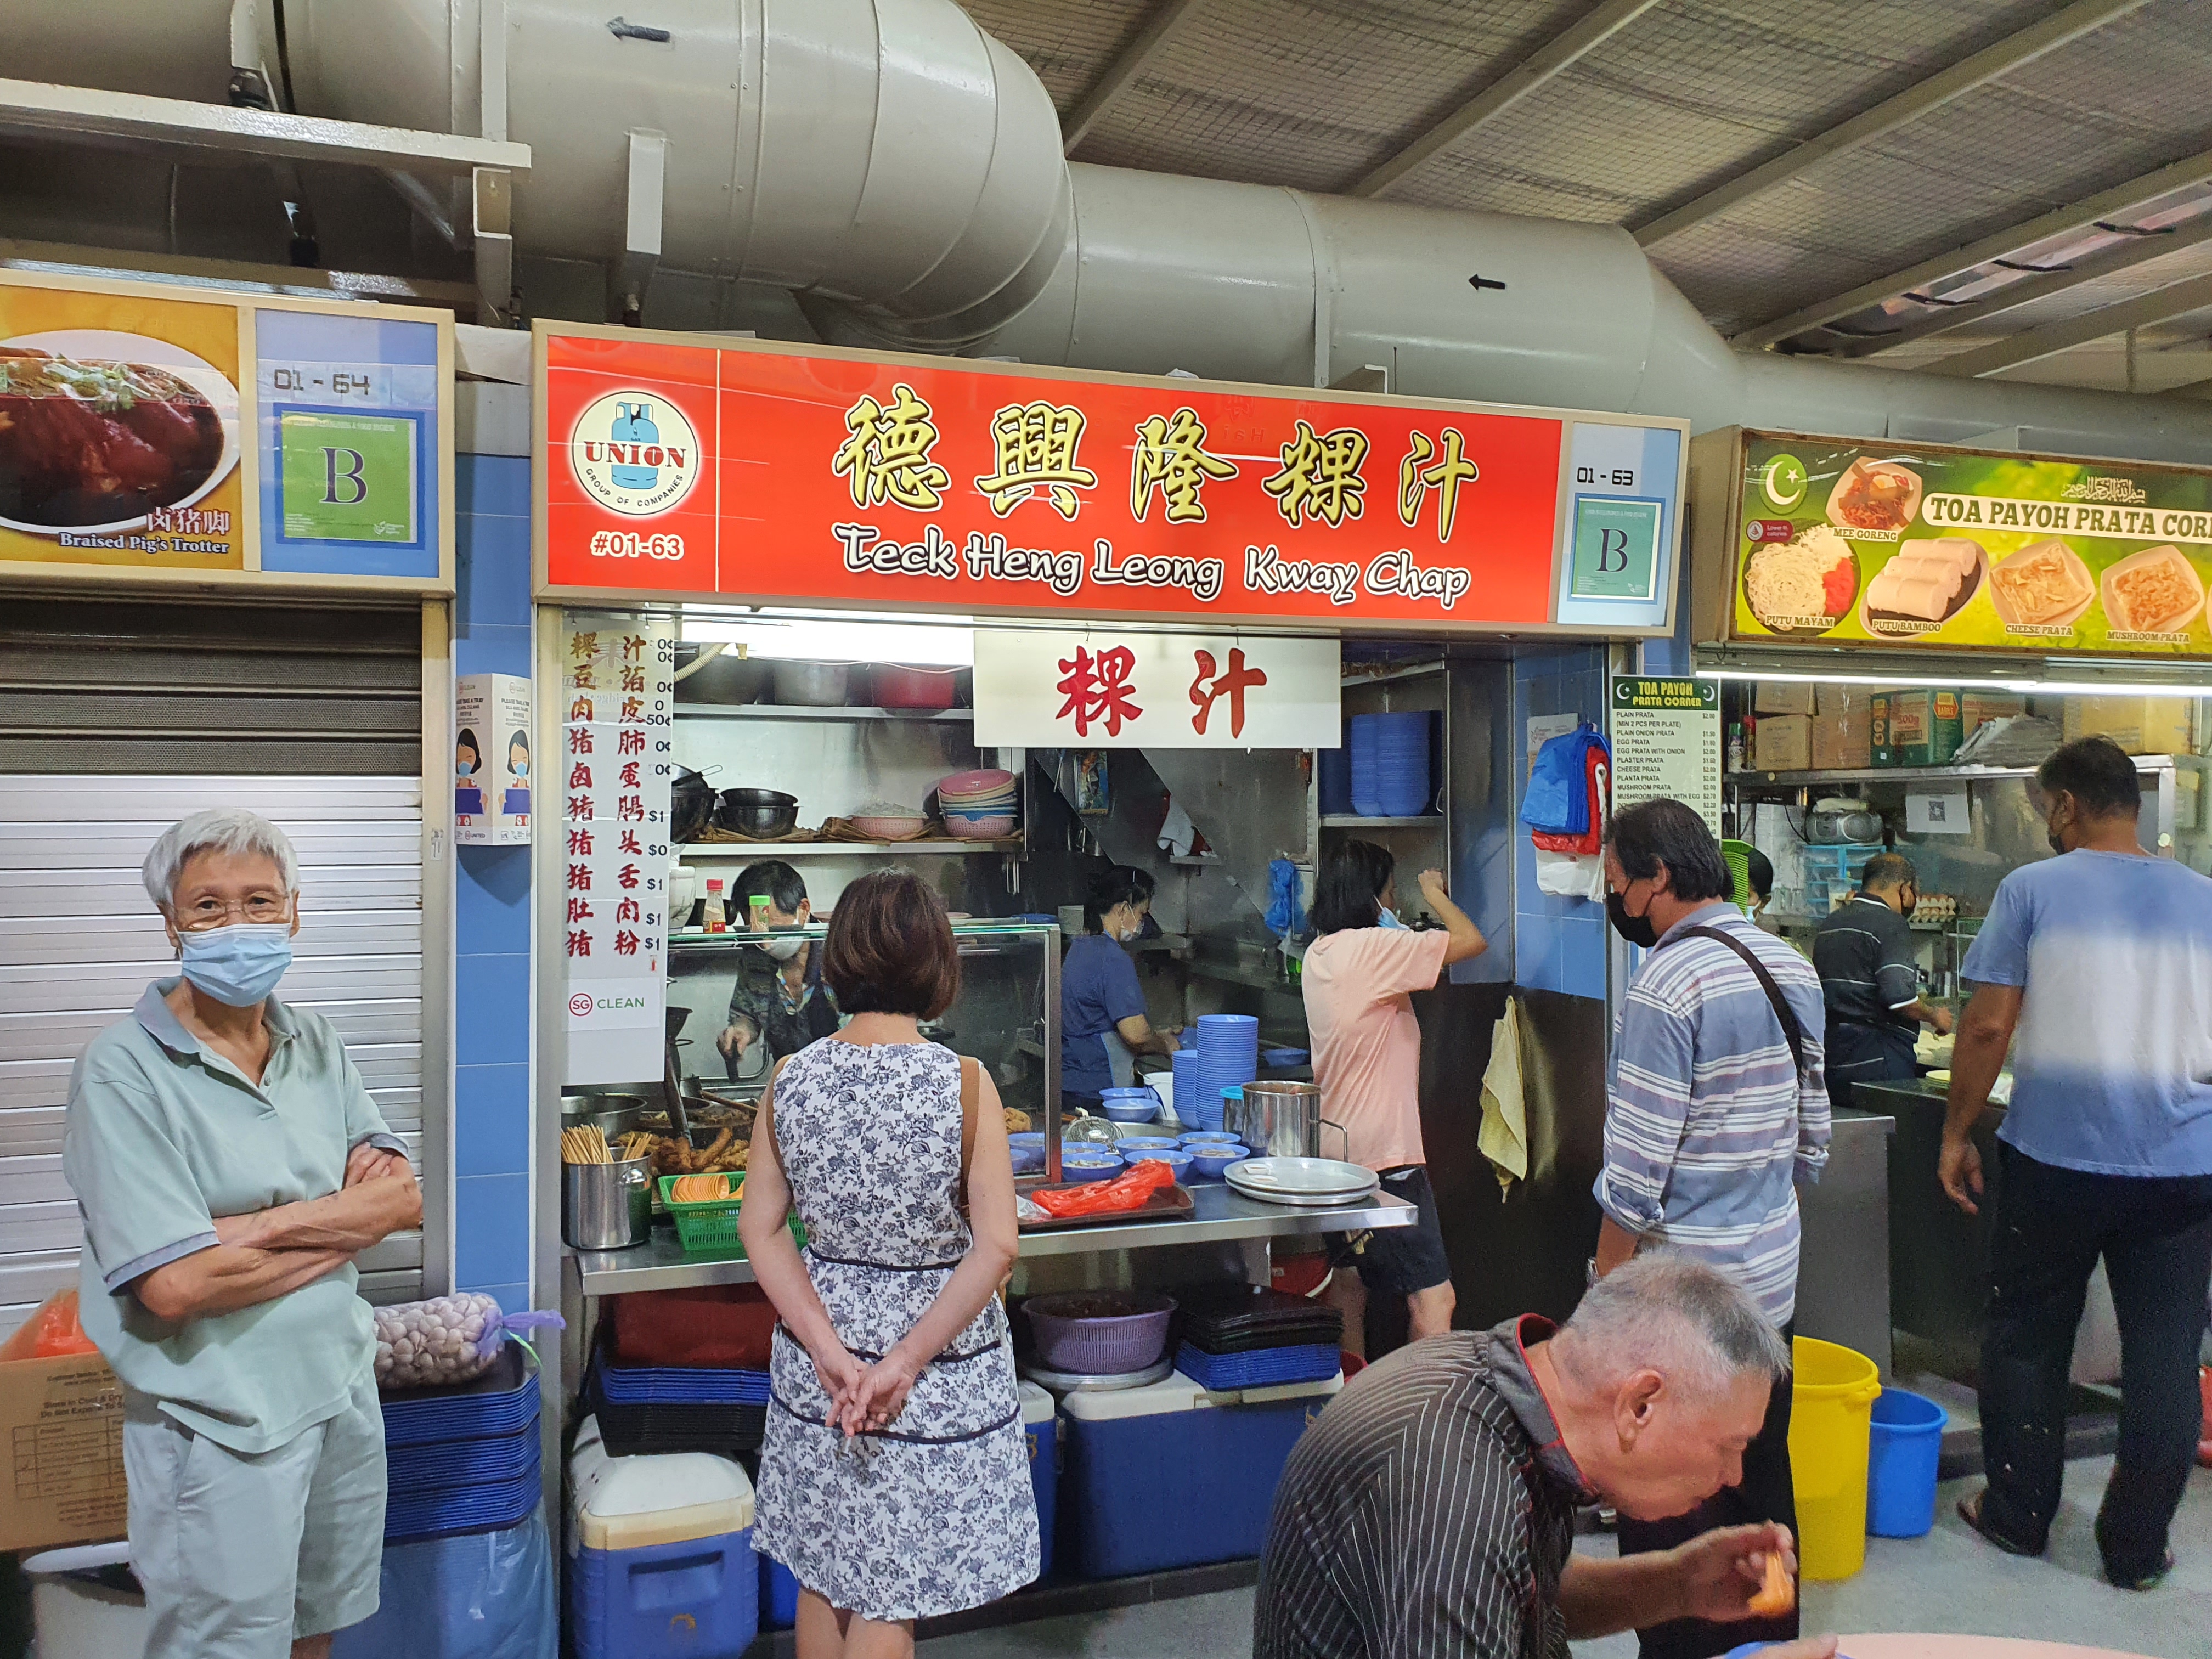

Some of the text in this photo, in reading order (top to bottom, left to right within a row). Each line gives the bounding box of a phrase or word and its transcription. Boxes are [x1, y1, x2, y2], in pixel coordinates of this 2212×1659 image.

[274, 369, 304, 391] 01
[333, 374, 370, 396] 64
[584, 441, 686, 468] UNION
[832, 382, 1479, 543] 德興隆粿汁
[319, 447, 368, 505] B
[586, 468, 683, 506] GROUP OF COMPANIES
[1577, 467, 1594, 483] 01
[1612, 470, 1633, 486] 63
[146, 506, 229, 535] 卤猪脚
[1931, 496, 1982, 523] TOA
[1988, 501, 2070, 528] PAYOH
[2074, 507, 2155, 535] PRATA
[59, 532, 229, 553] Braised Pig's Trotter
[592, 532, 682, 558] #01-63
[1833, 528, 1897, 541] MEE GORENG
[1595, 528, 1628, 572] B
[831, 522, 1471, 610] Teck Heng Leong Kway Chap
[1767, 616, 1833, 627] PUTU MAYAM
[1872, 620, 1941, 632] PUTU BAMBOO
[2005, 624, 2073, 635] CHEESE PRATA
[2107, 631, 2190, 642] MUSHROOM PRATA
[1056, 645, 1267, 739] 粿汁
[1638, 681, 1693, 696] TOA PAYOH
[571, 695, 646, 723] 肉皮
[1633, 697, 1702, 707] PRATA CORNER
[568, 727, 646, 756] 猪肺
[648, 810, 664, 822] $1
[566, 828, 642, 856] 猪头
[648, 844, 667, 856] $0
[566, 863, 641, 890] 猪舌
[647, 878, 662, 890] $1
[646, 913, 661, 926] $1
[645, 938, 659, 951] $1
[573, 998, 644, 1009] SG CLEAN
